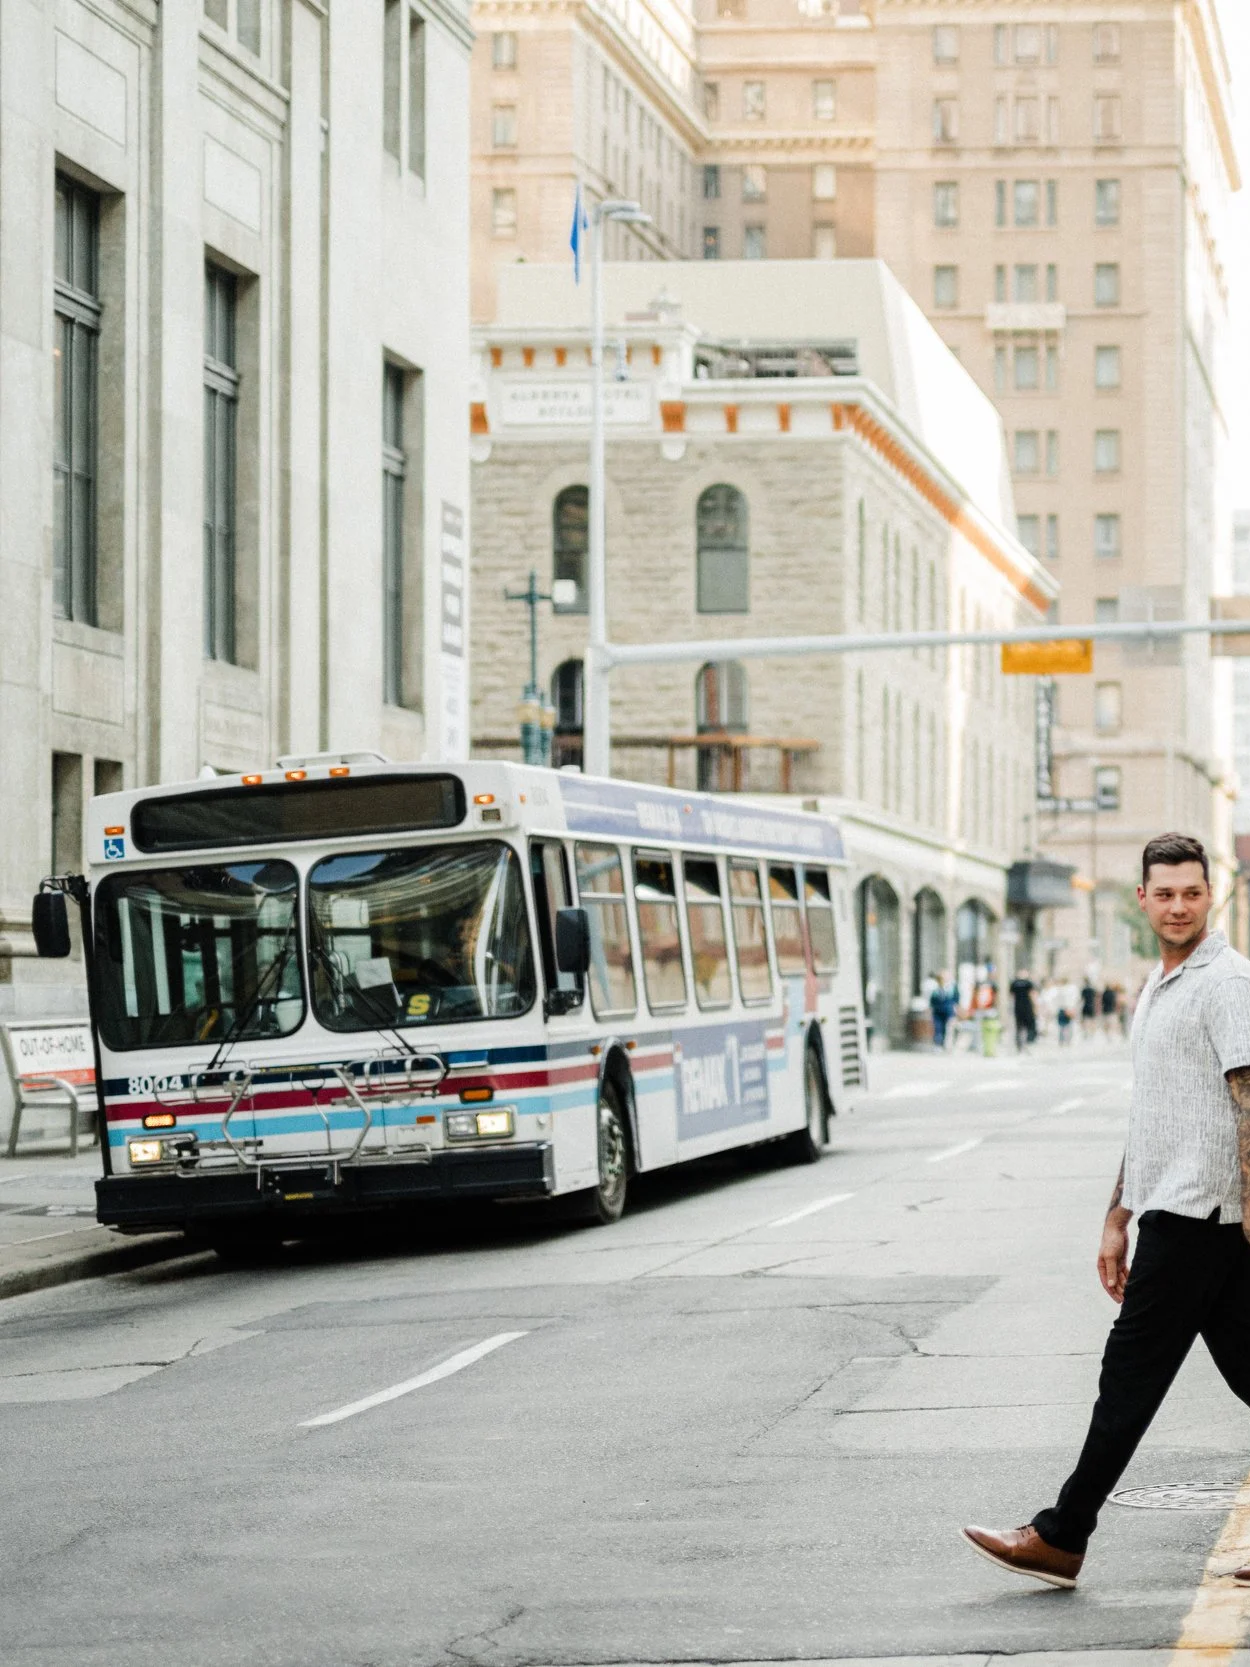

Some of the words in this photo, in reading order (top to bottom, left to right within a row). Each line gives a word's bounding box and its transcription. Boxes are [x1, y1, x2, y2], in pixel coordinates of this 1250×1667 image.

[407, 994, 430, 1016] S
[20, 1035, 86, 1057] OUT-OF-HOME
[128, 1075, 183, 1095] 8004
